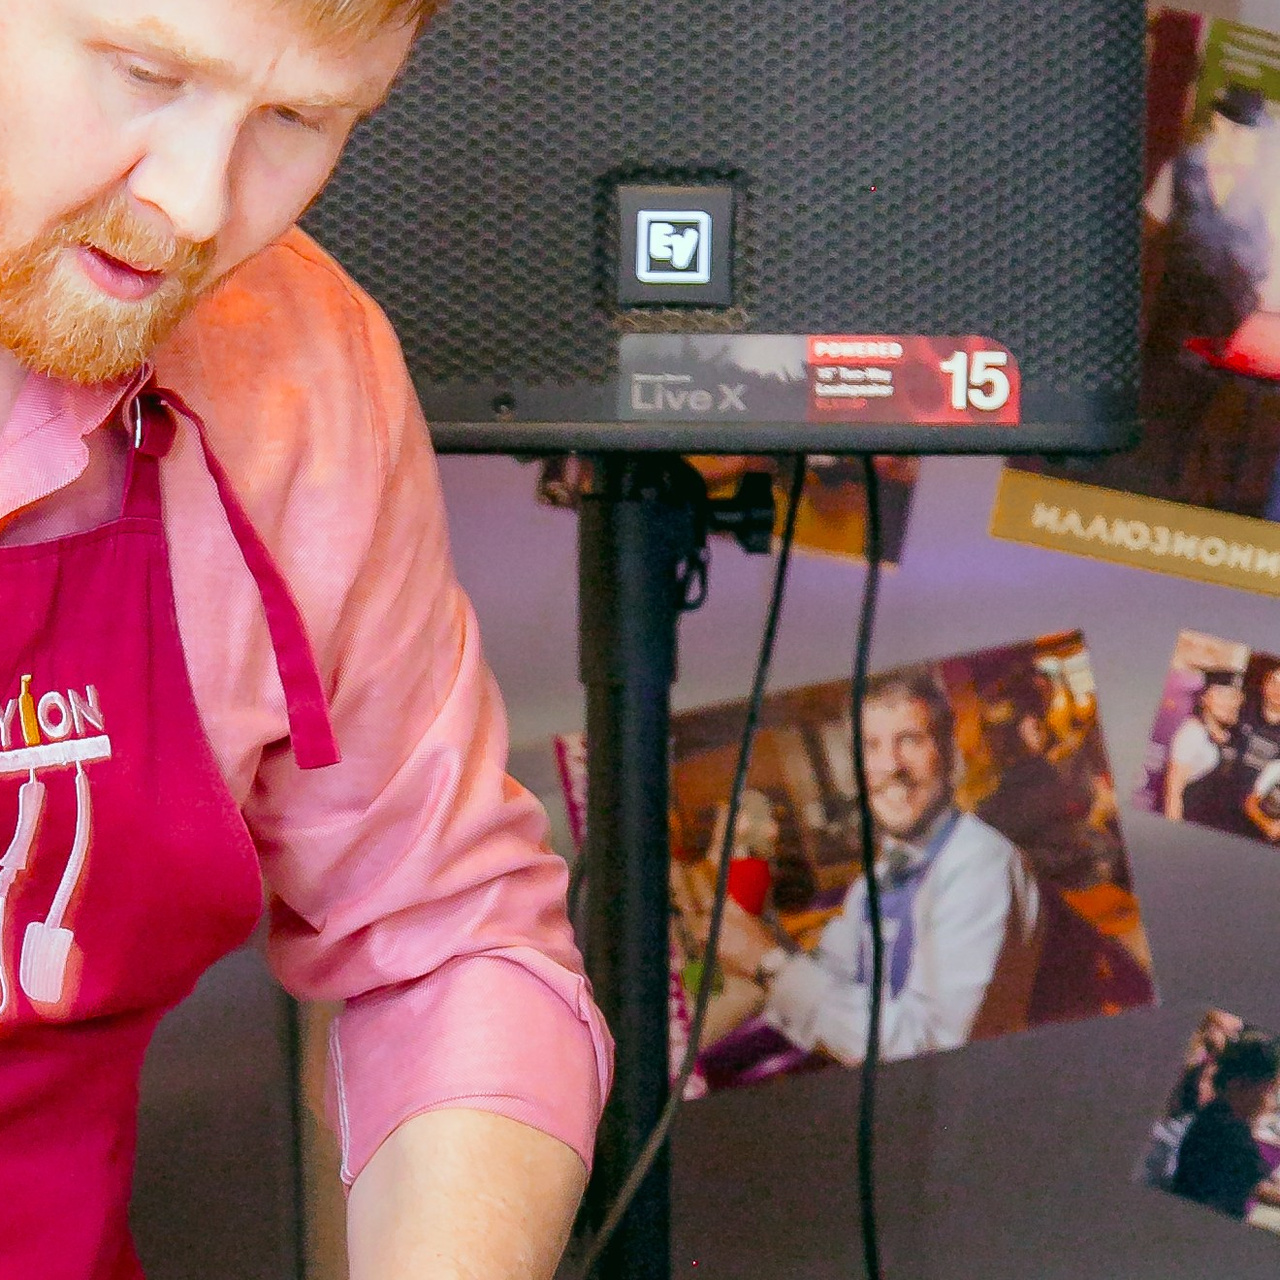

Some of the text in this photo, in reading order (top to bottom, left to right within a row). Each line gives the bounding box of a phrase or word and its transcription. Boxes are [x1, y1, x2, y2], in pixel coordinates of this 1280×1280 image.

[630, 382, 748, 412] Live X
[939, 349, 1011, 411] 15
